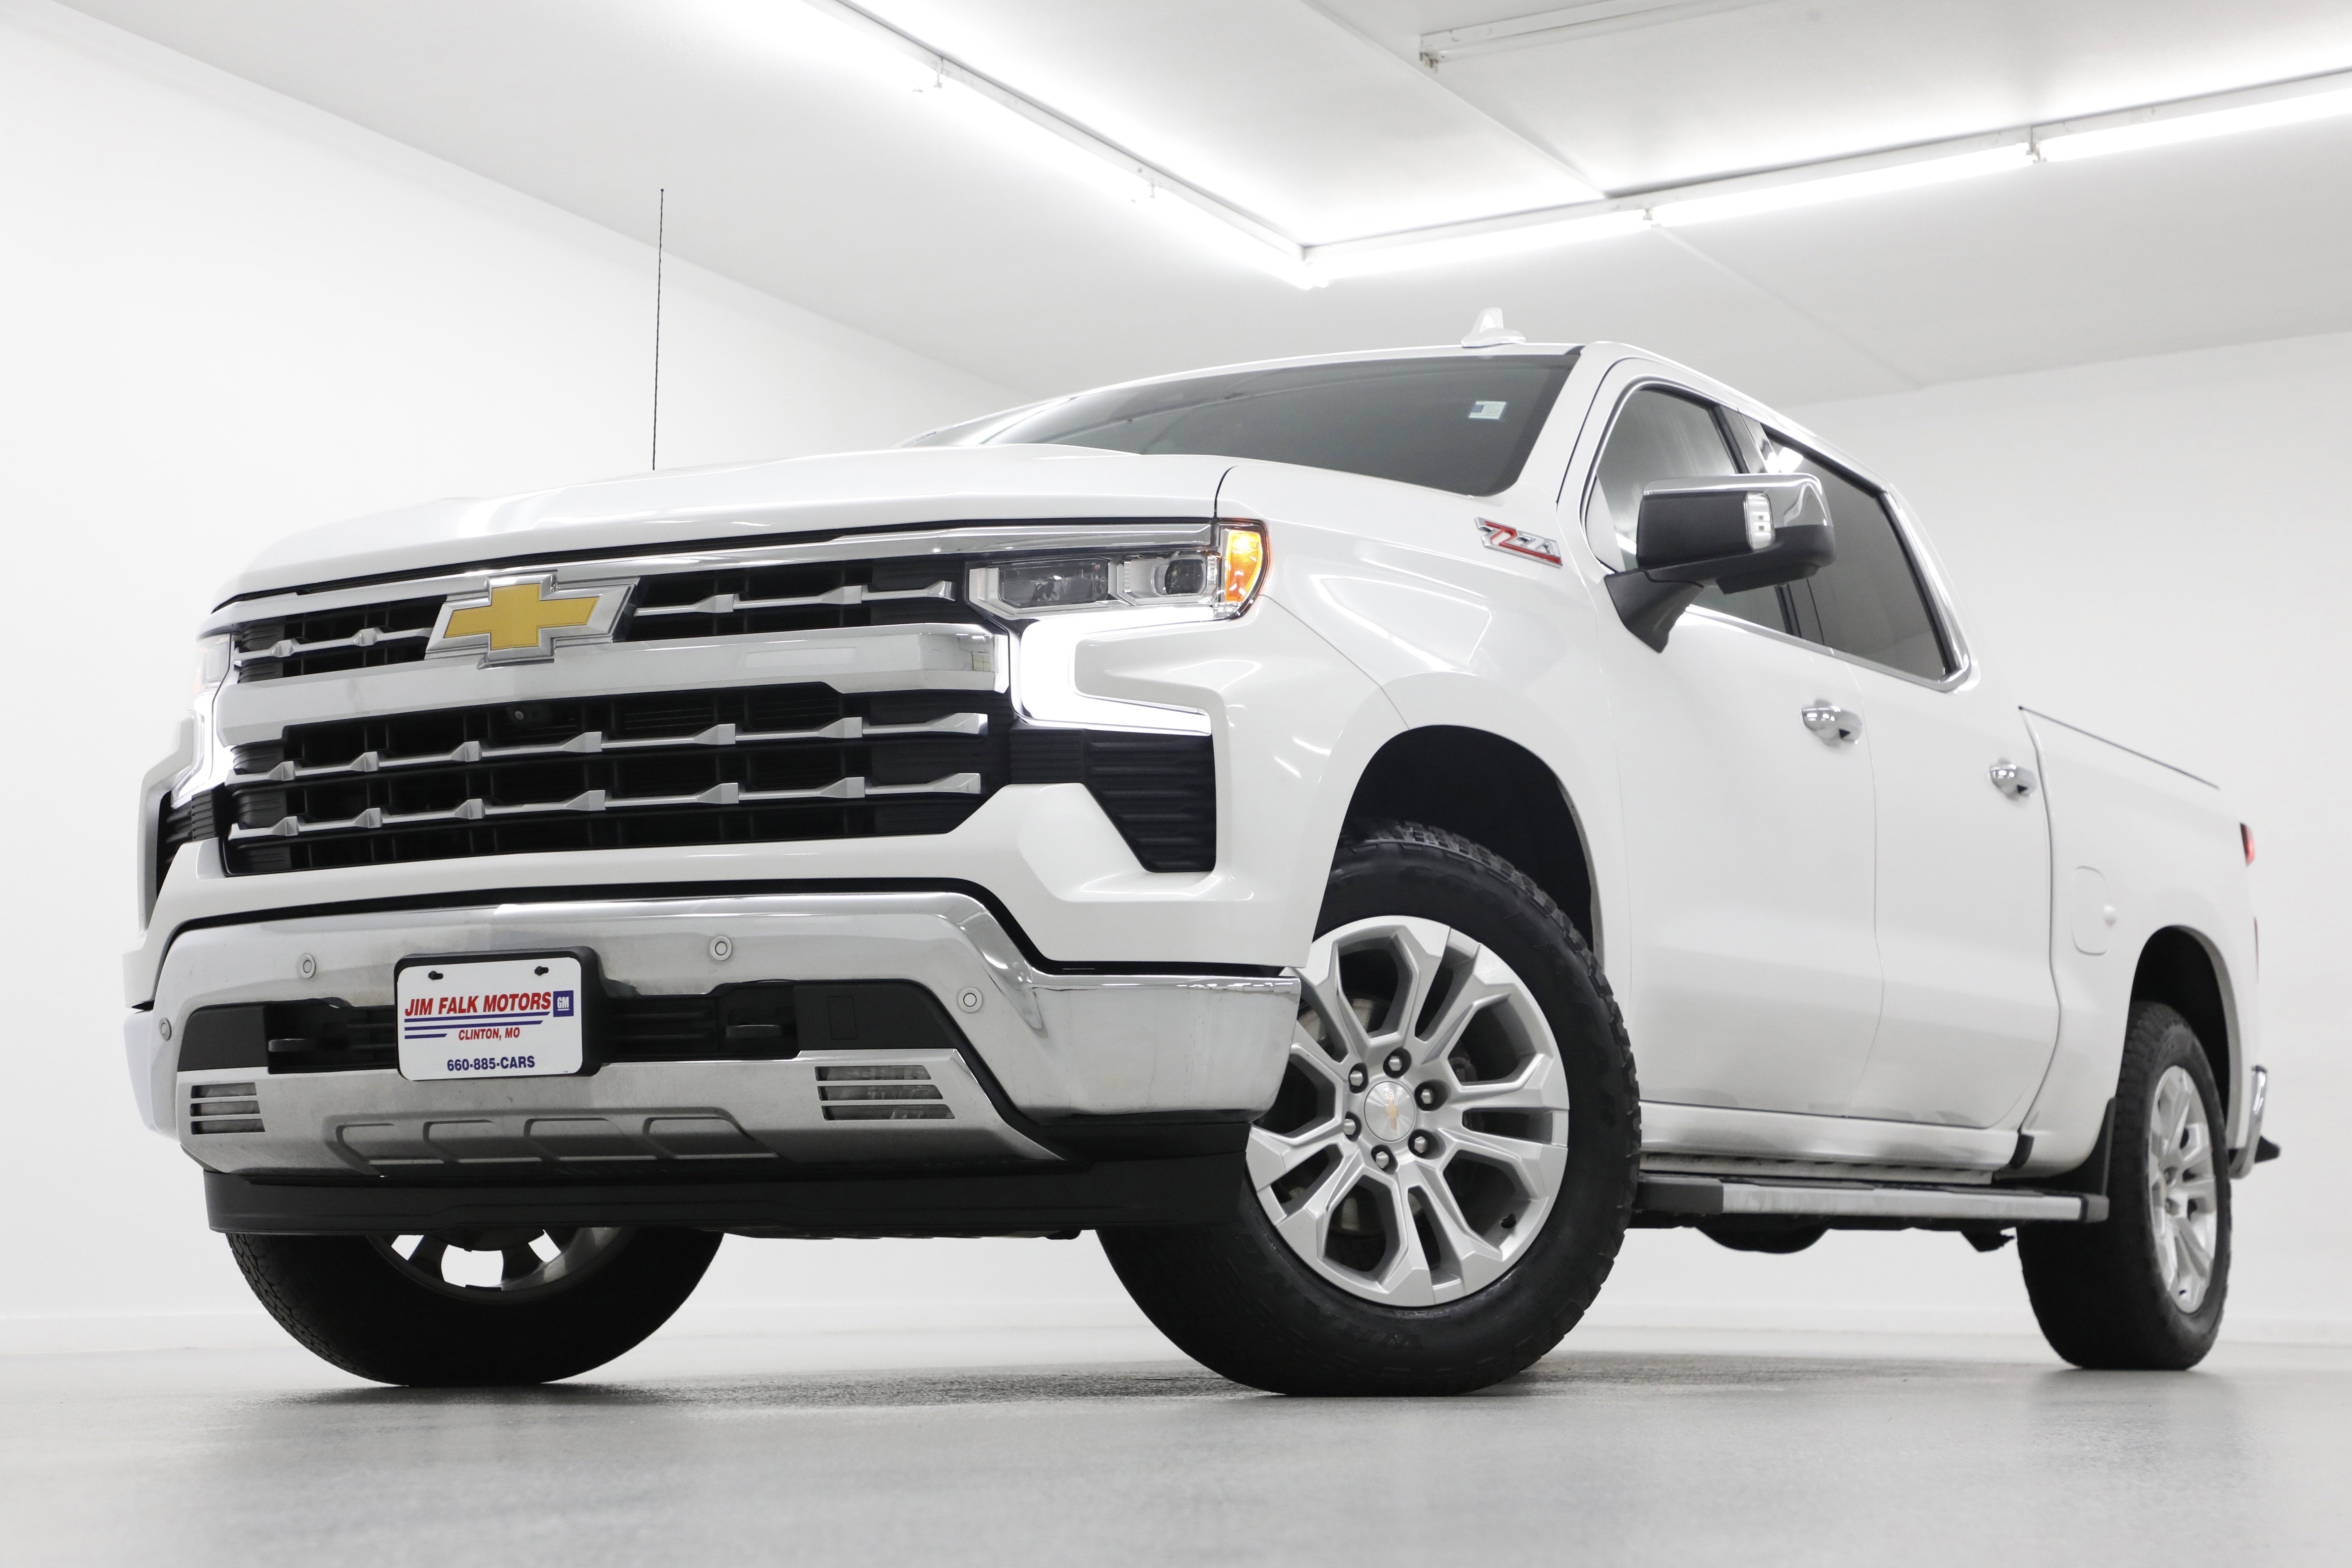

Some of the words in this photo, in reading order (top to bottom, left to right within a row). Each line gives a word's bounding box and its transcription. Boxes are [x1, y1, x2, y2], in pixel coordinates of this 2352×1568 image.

[1474, 517, 1563, 568] Z71
[405, 998, 434, 1017] JIM
[438, 996, 479, 1015] FALK
[483, 992, 552, 1013] MOTORS
[557, 996, 570, 1009] GM
[459, 1028, 502, 1041] CLINTON,
[505, 1027, 520, 1038] MO
[447, 1056, 535, 1071] 660-885-CARS
